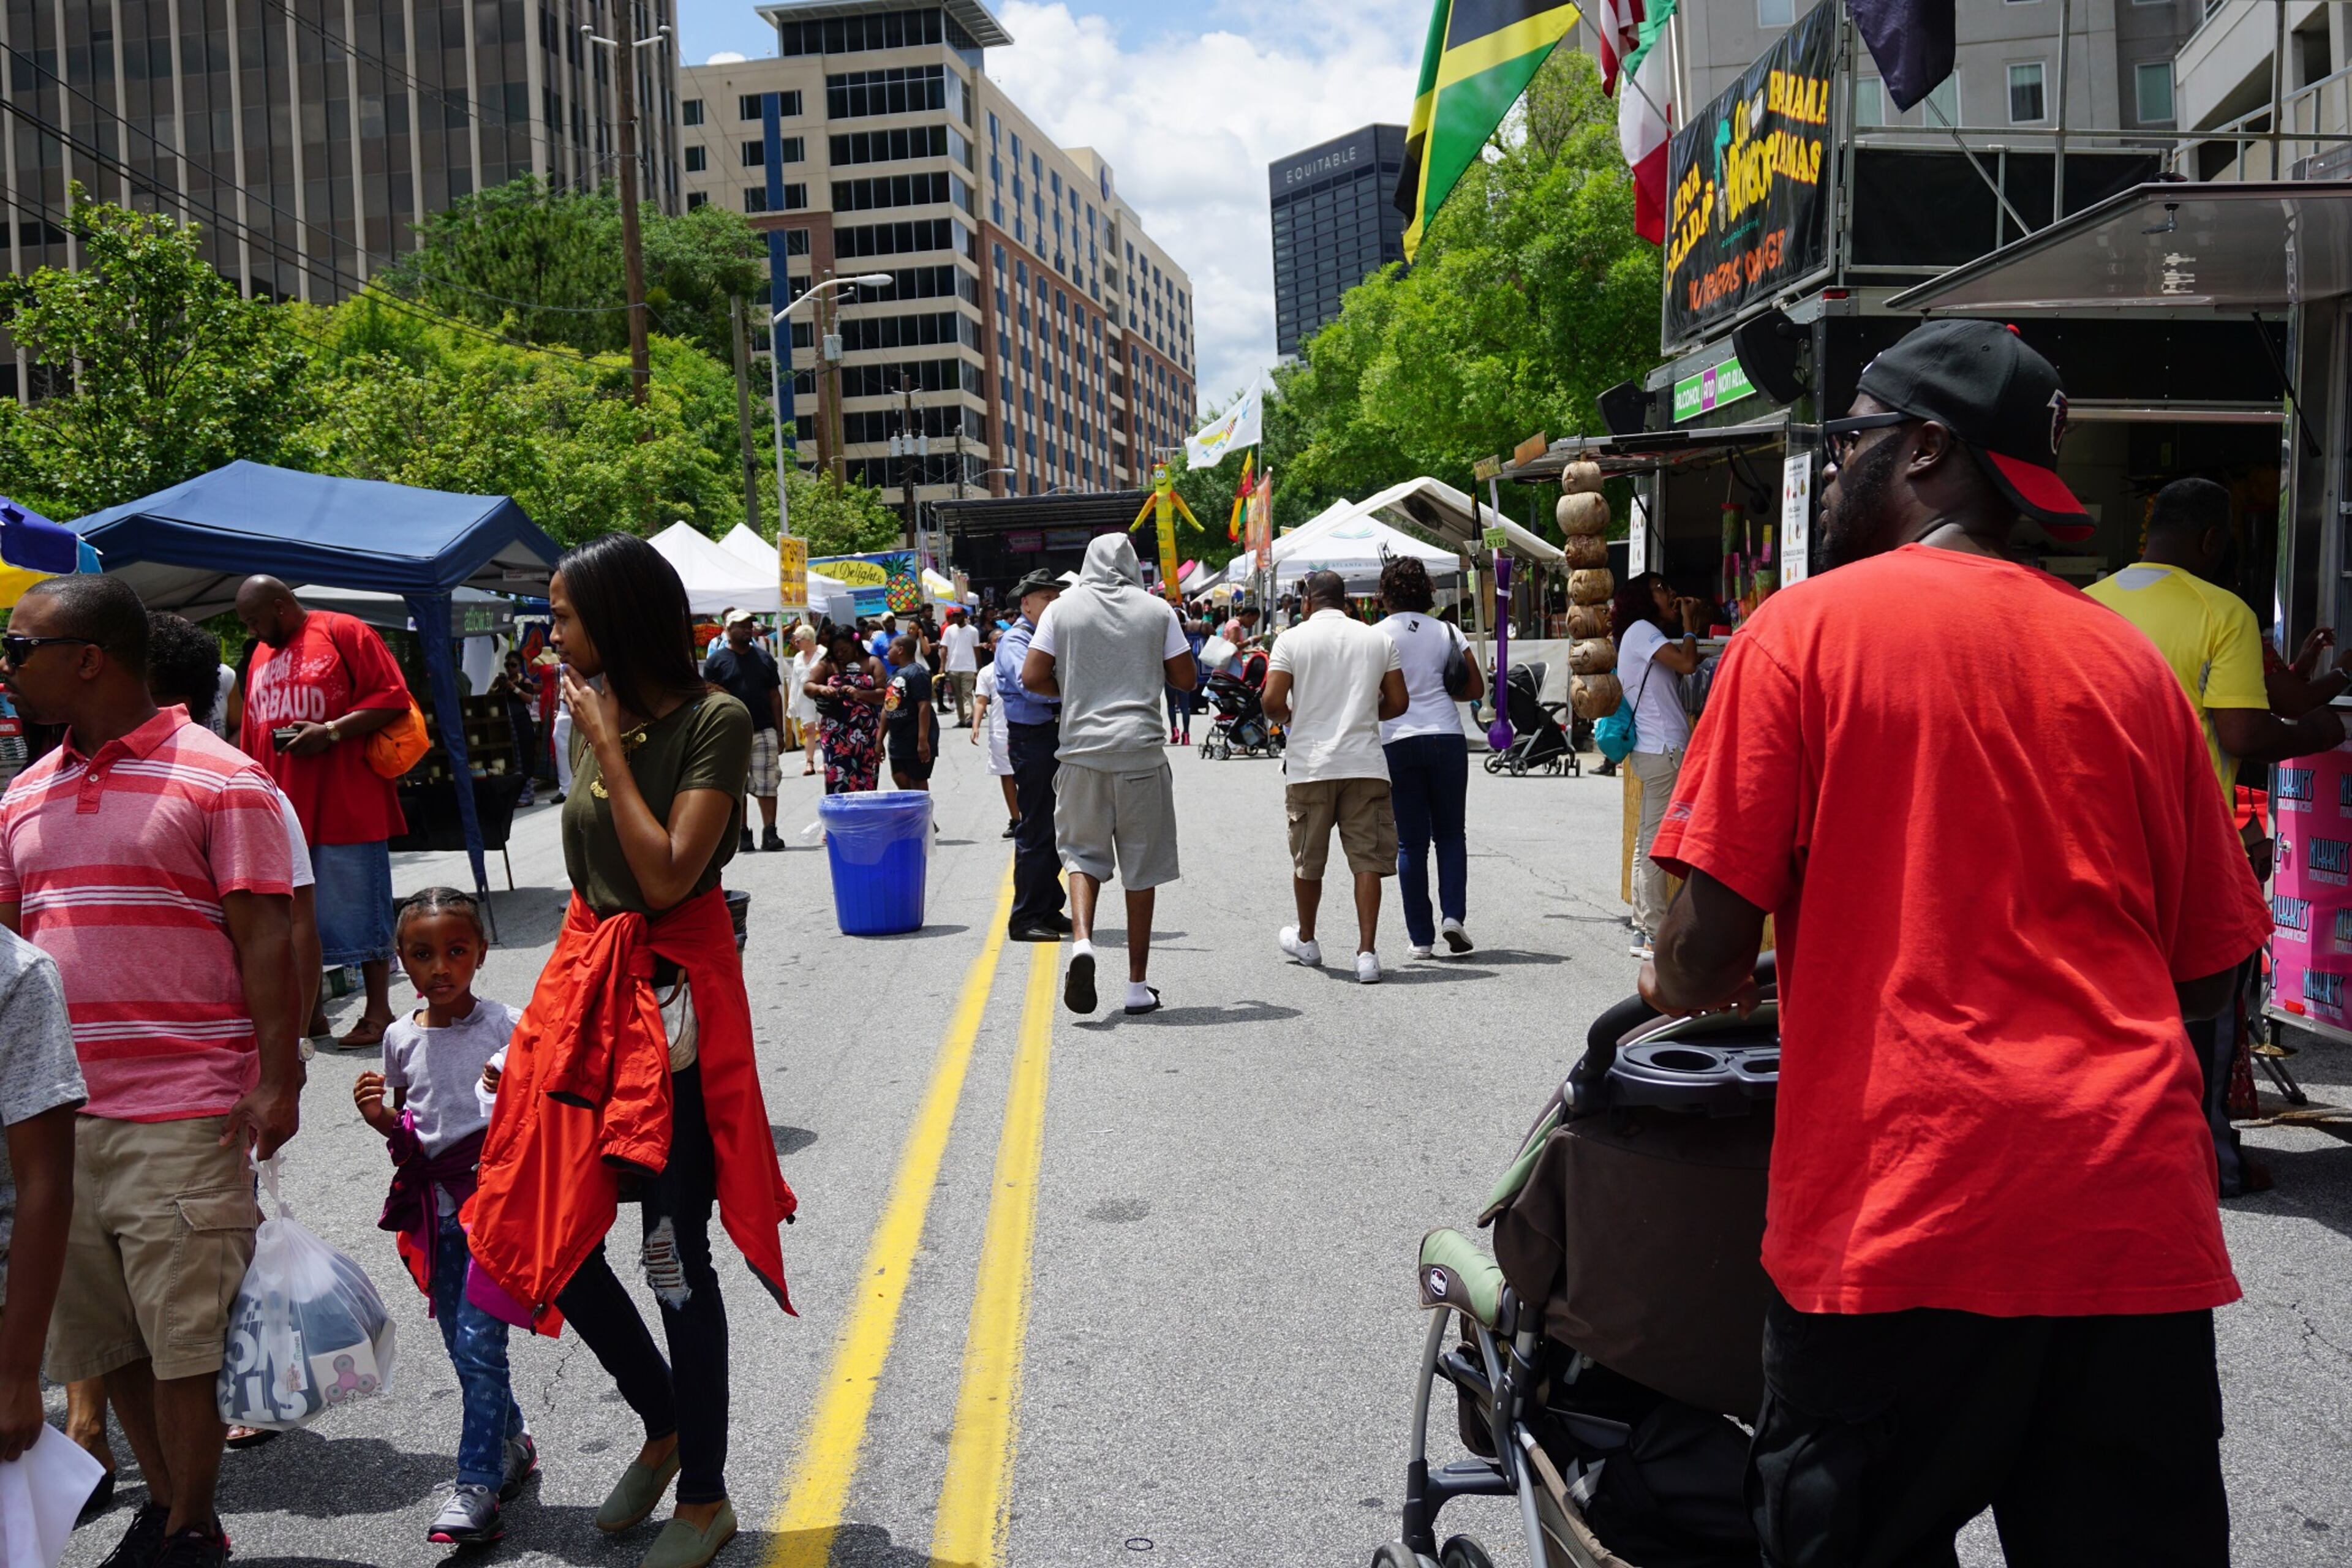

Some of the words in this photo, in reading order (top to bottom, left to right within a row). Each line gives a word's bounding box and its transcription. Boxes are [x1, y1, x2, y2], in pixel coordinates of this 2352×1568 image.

[1286, 146, 1357, 183] EQUITABLE
[1676, 385, 1700, 411] ALCOHOL
[1703, 379, 1715, 400] AND
[1486, 538, 1505, 549] $18
[839, 562, 883, 584] Delights
